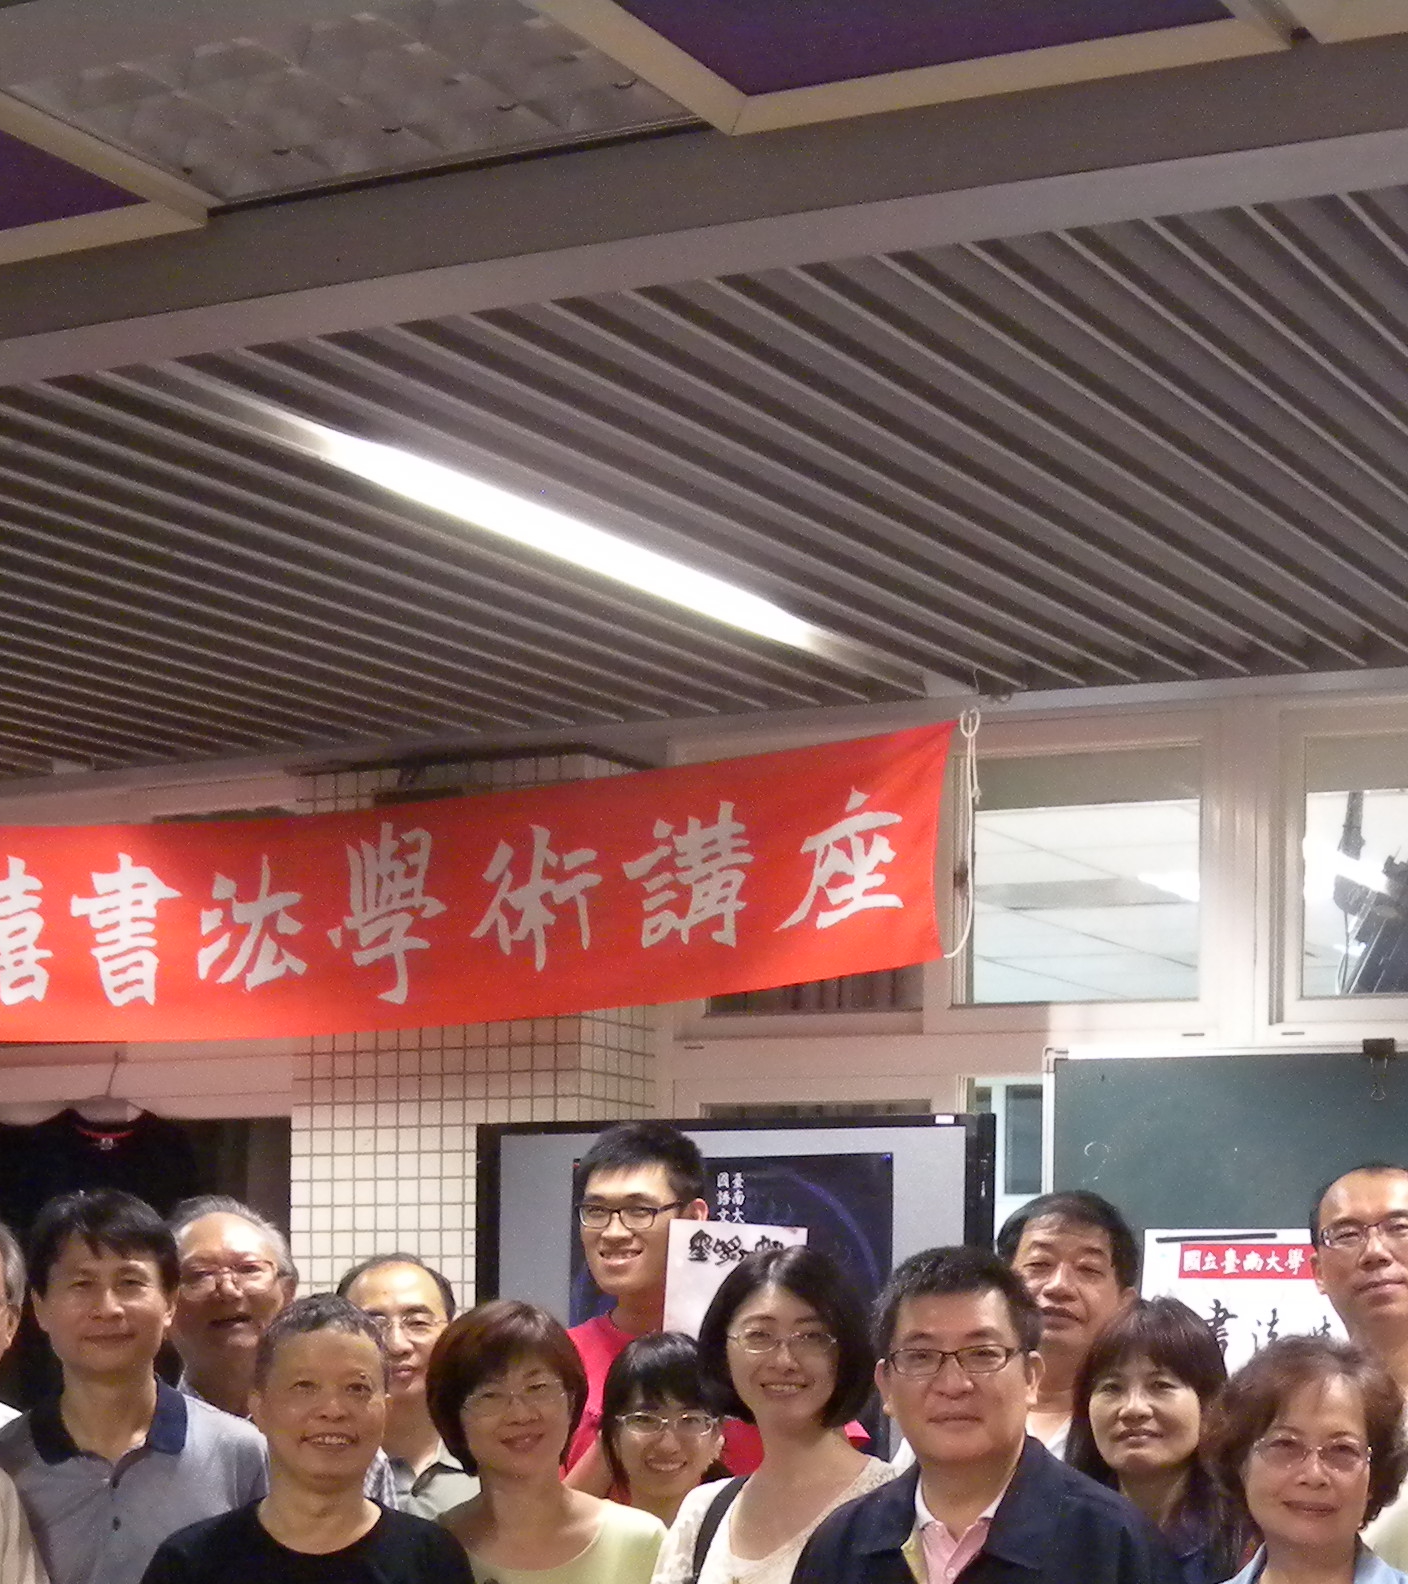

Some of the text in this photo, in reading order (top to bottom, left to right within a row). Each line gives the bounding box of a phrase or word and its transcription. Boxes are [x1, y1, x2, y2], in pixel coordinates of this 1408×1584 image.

[1183, 1247, 1305, 1276] 國立臺南大學
